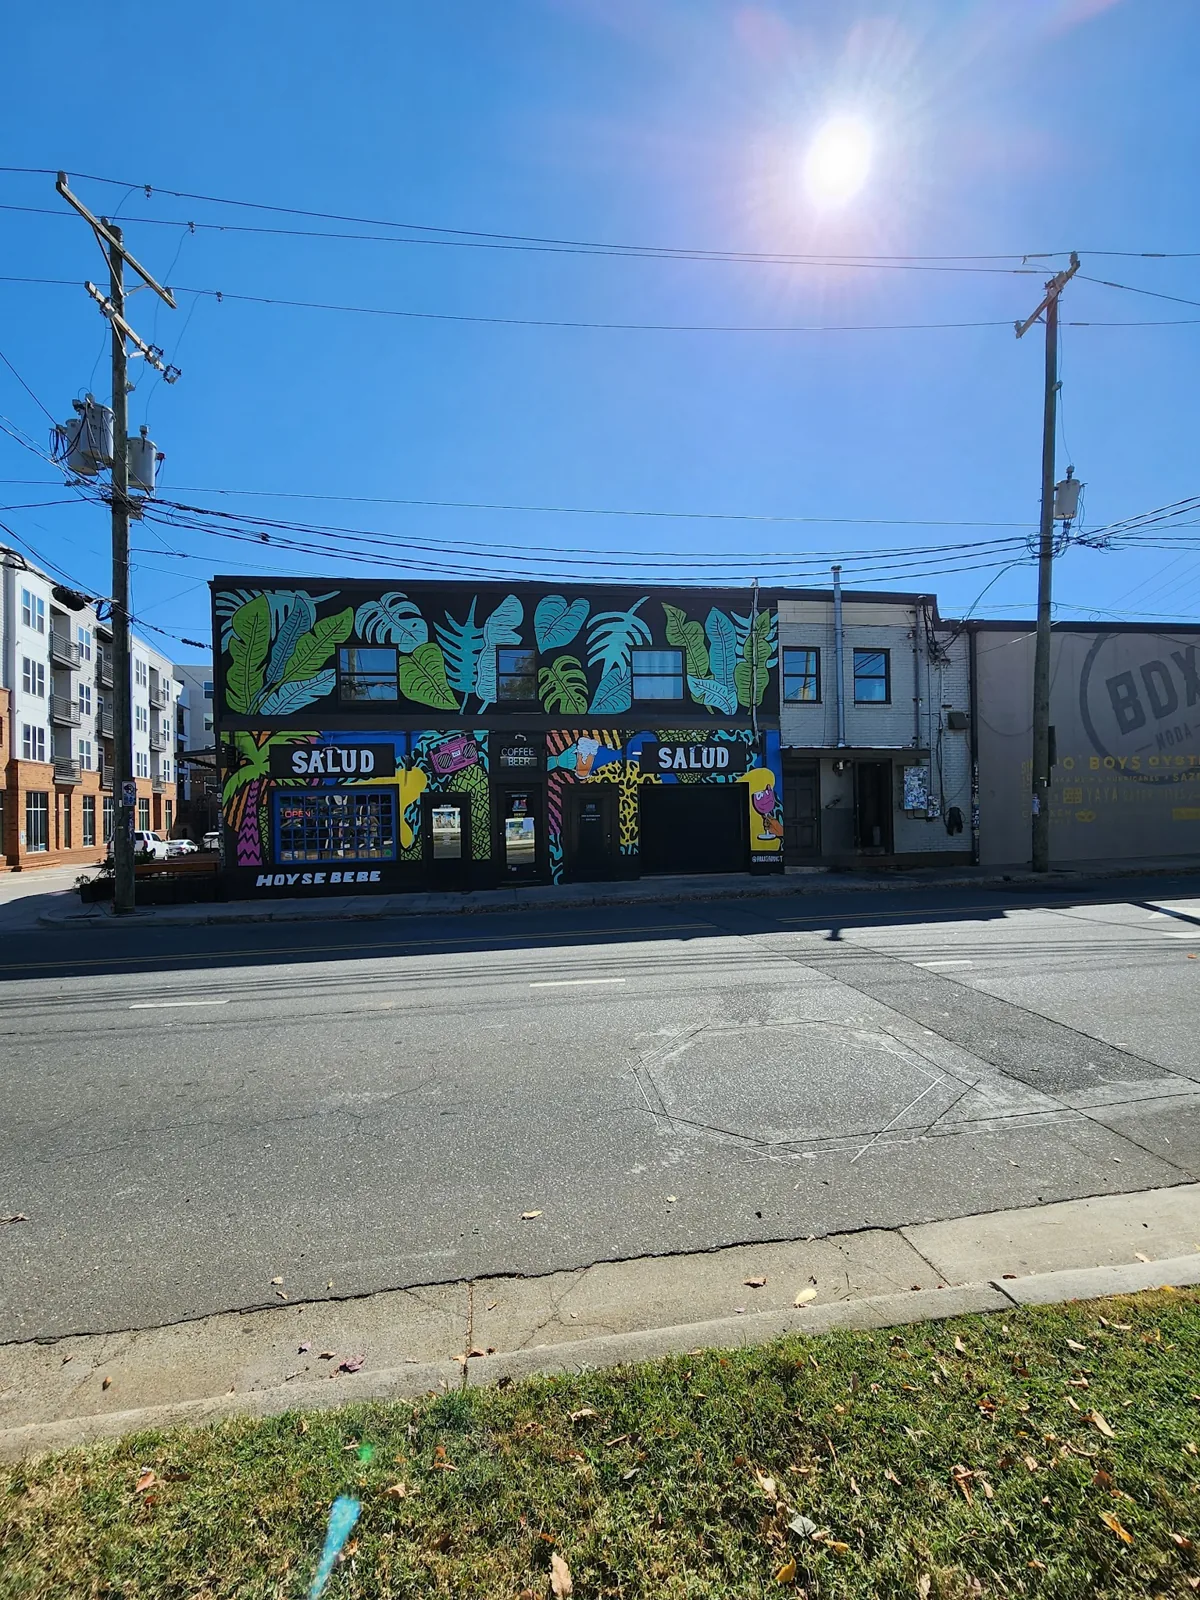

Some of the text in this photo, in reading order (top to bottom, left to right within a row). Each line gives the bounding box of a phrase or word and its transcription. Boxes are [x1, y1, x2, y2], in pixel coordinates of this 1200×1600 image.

[1155, 722, 1192, 750] NODA
[501, 747, 534, 756] COFFEE
[658, 747, 729, 769] SALUD
[292, 750, 374, 773] SALUD
[508, 757, 530, 766] BEER
[1089, 756, 1141, 770] BOYS
[1149, 755, 1200, 769] OYST
[285, 810, 311, 818] OPEN
[256, 871, 381, 886] HOY SE BEBE
